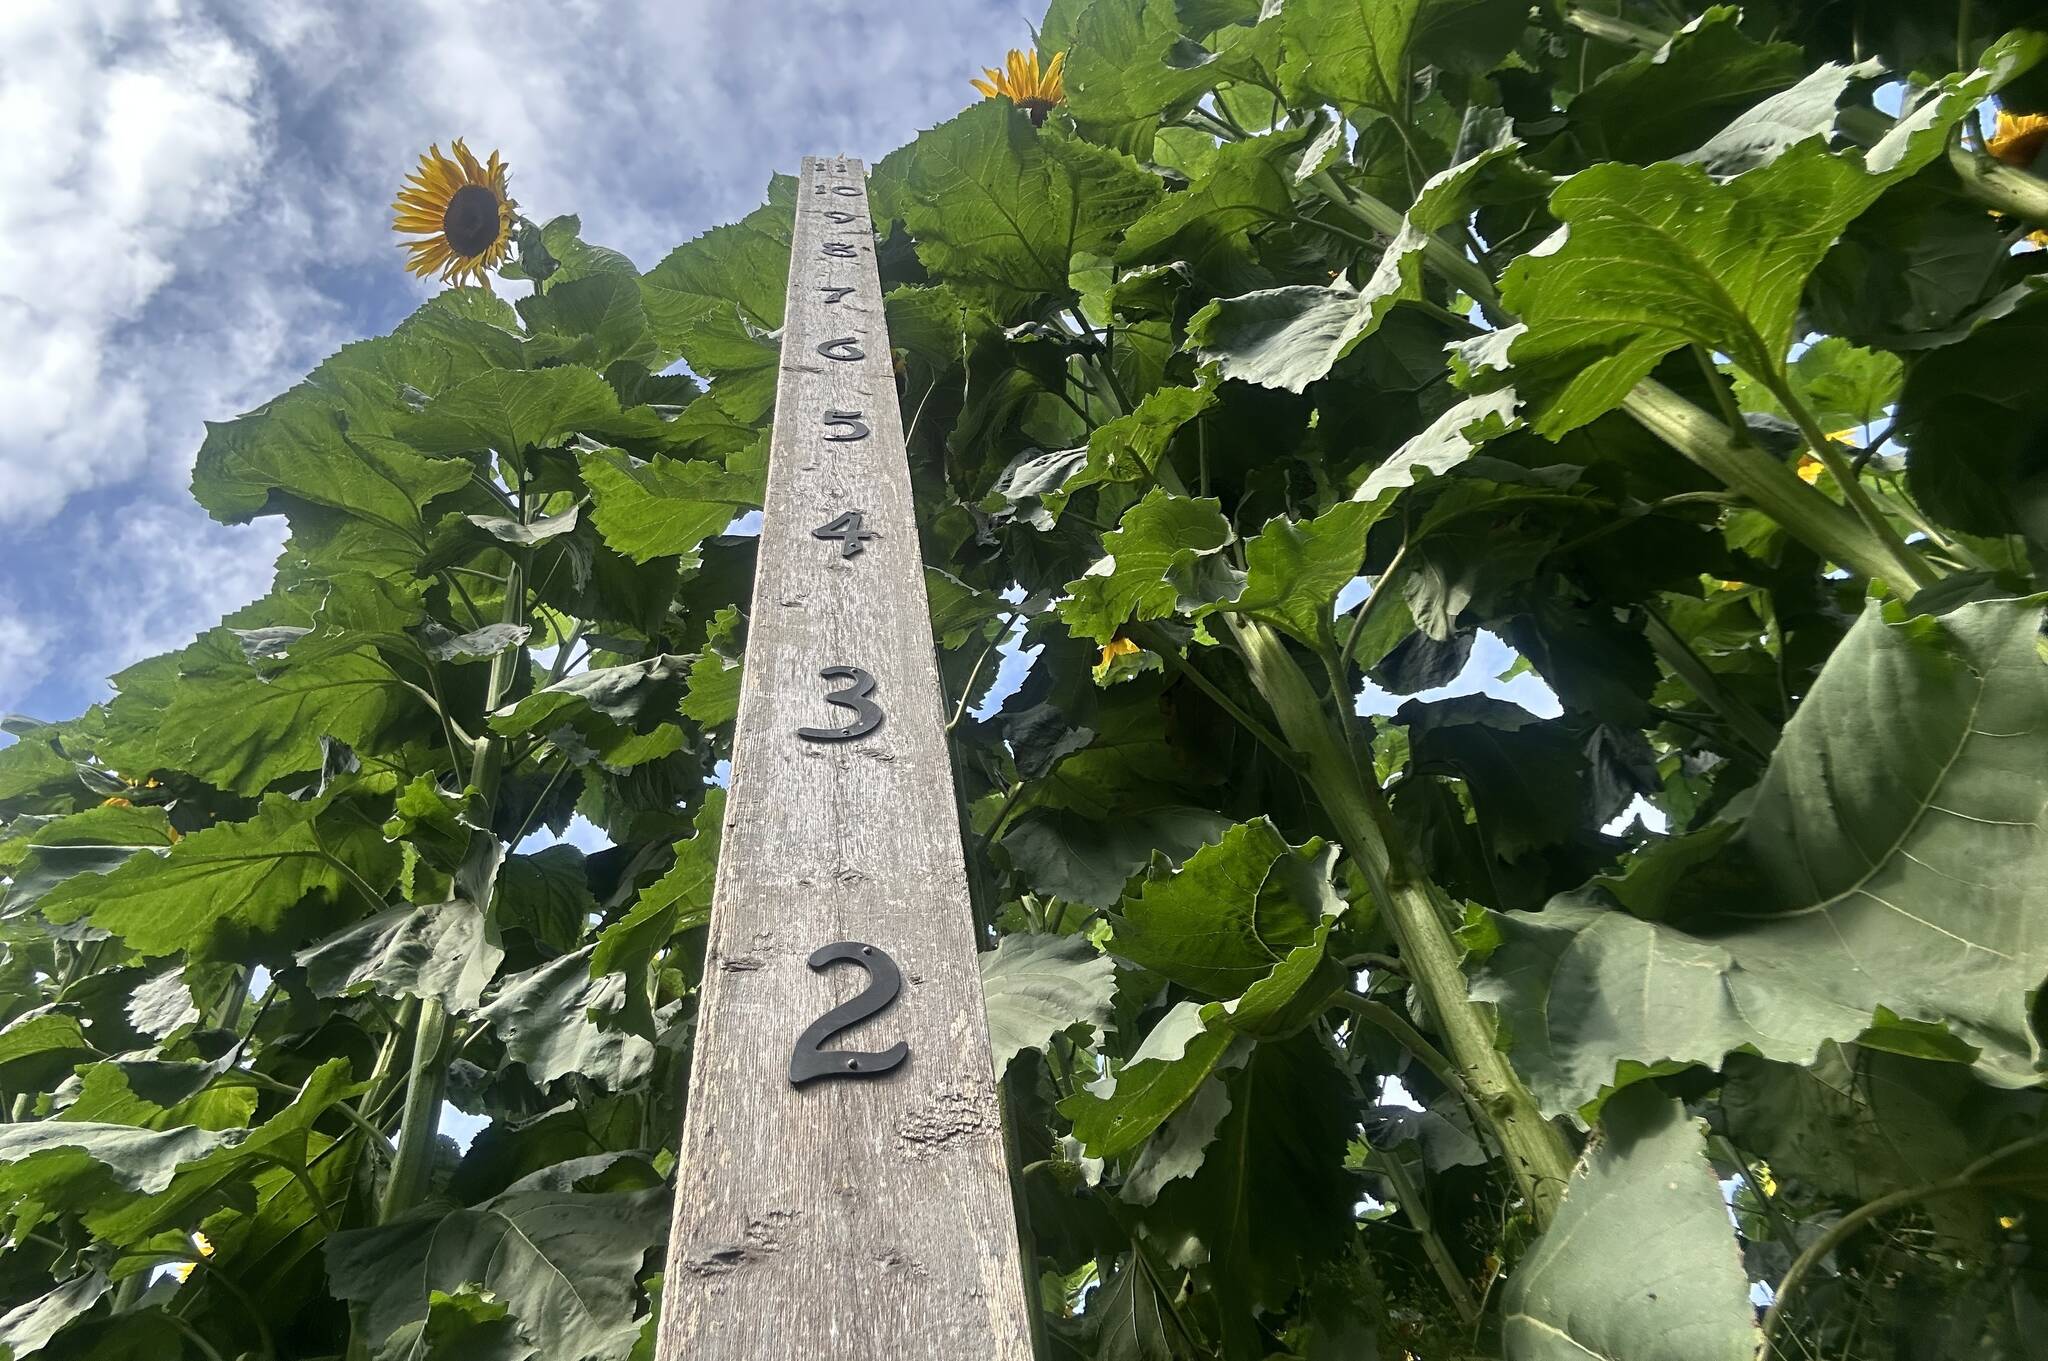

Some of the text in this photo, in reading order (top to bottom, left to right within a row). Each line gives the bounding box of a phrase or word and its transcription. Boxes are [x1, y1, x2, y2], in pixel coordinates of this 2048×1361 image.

[815, 184, 863, 197] 10
[823, 211, 855, 224] 9
[821, 242, 858, 258] 8
[821, 286, 856, 304] 7
[817, 337, 865, 361] 6
[823, 410, 870, 442] 5
[811, 511, 872, 559] 4
[798, 665, 883, 740] 3
[788, 941, 909, 1086] 2
